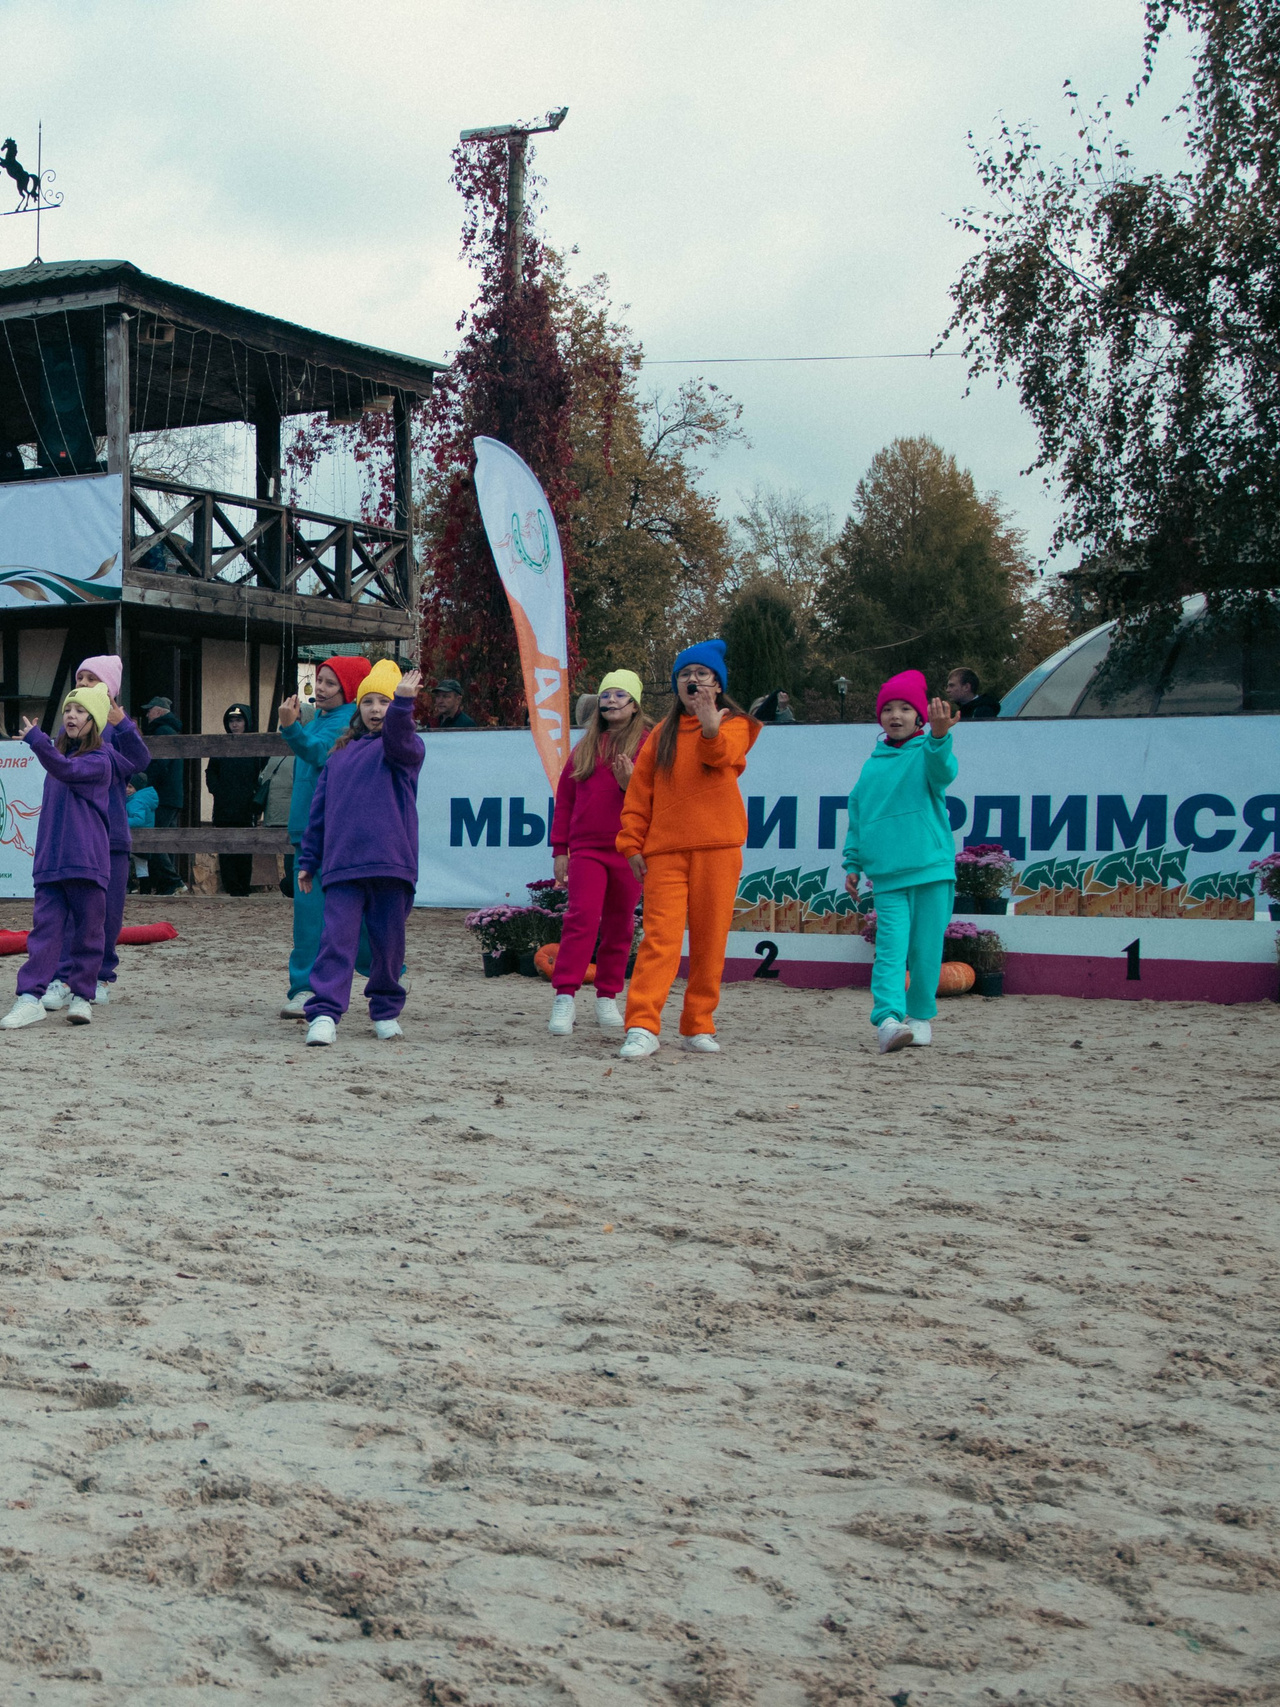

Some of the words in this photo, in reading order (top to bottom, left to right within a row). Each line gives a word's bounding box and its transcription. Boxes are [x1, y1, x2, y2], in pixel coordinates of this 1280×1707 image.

[818, 793, 1280, 861] ГДИМСЯ
[754, 940, 780, 978] 2
[1121, 938, 1140, 981] 1
